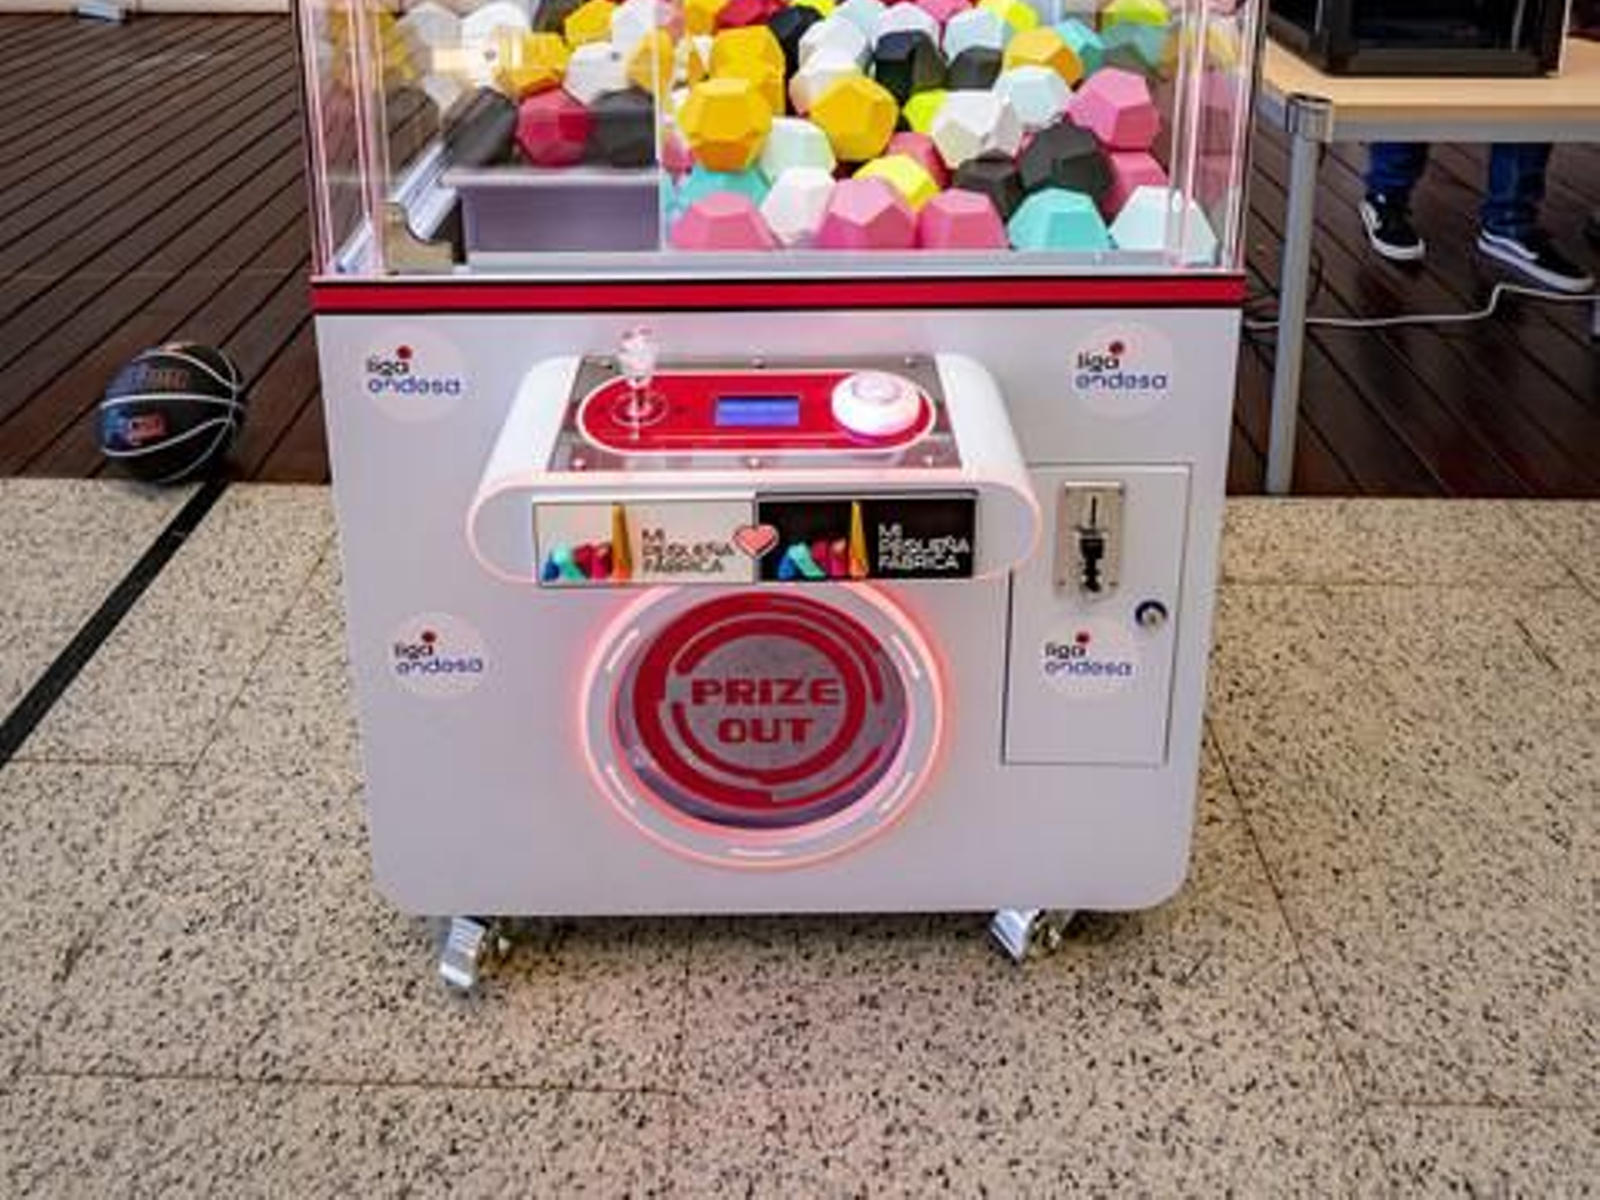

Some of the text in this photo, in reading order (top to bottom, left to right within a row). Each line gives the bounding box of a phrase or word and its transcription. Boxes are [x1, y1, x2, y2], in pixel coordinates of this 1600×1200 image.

[1077, 351, 1119, 372] liga
[1075, 372, 1167, 390] endesa
[692, 678, 841, 706] PRIZE
[717, 718, 815, 744] OUT
